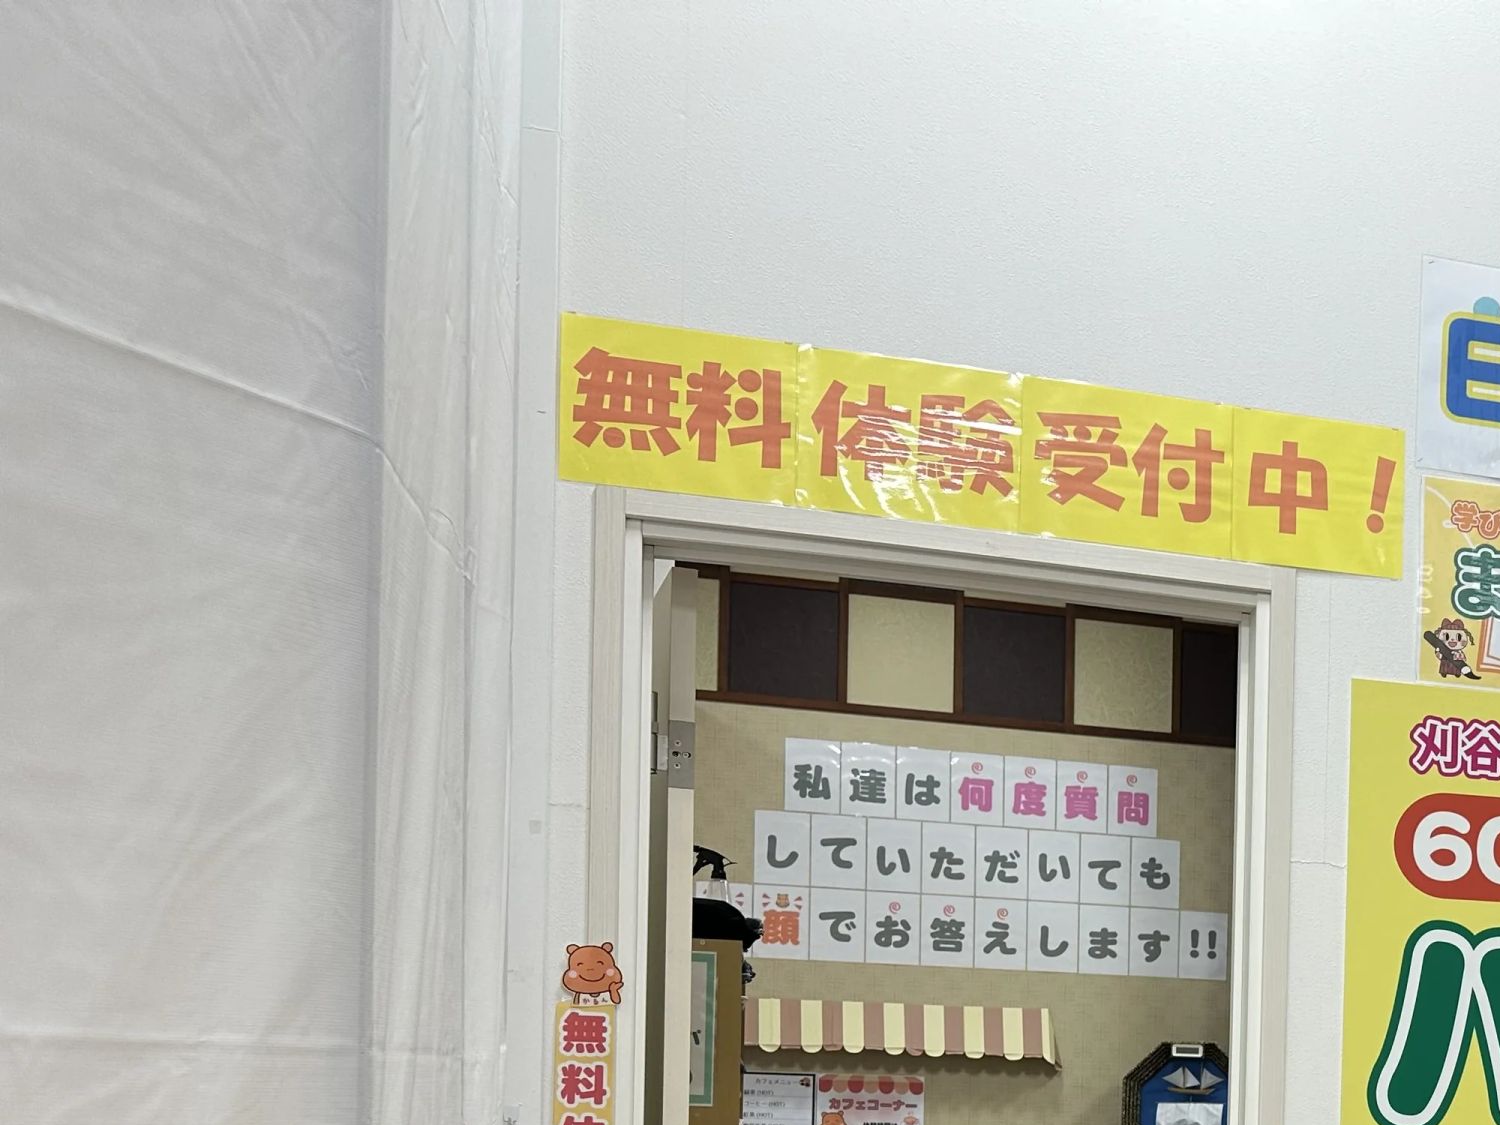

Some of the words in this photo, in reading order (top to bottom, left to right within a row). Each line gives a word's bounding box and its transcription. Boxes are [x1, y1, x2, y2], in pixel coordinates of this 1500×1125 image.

[793, 763, 1149, 826] 私達は何度質問
[766, 835, 1172, 891] していただいても
[829, 1097, 918, 1112] カフェコーナー
